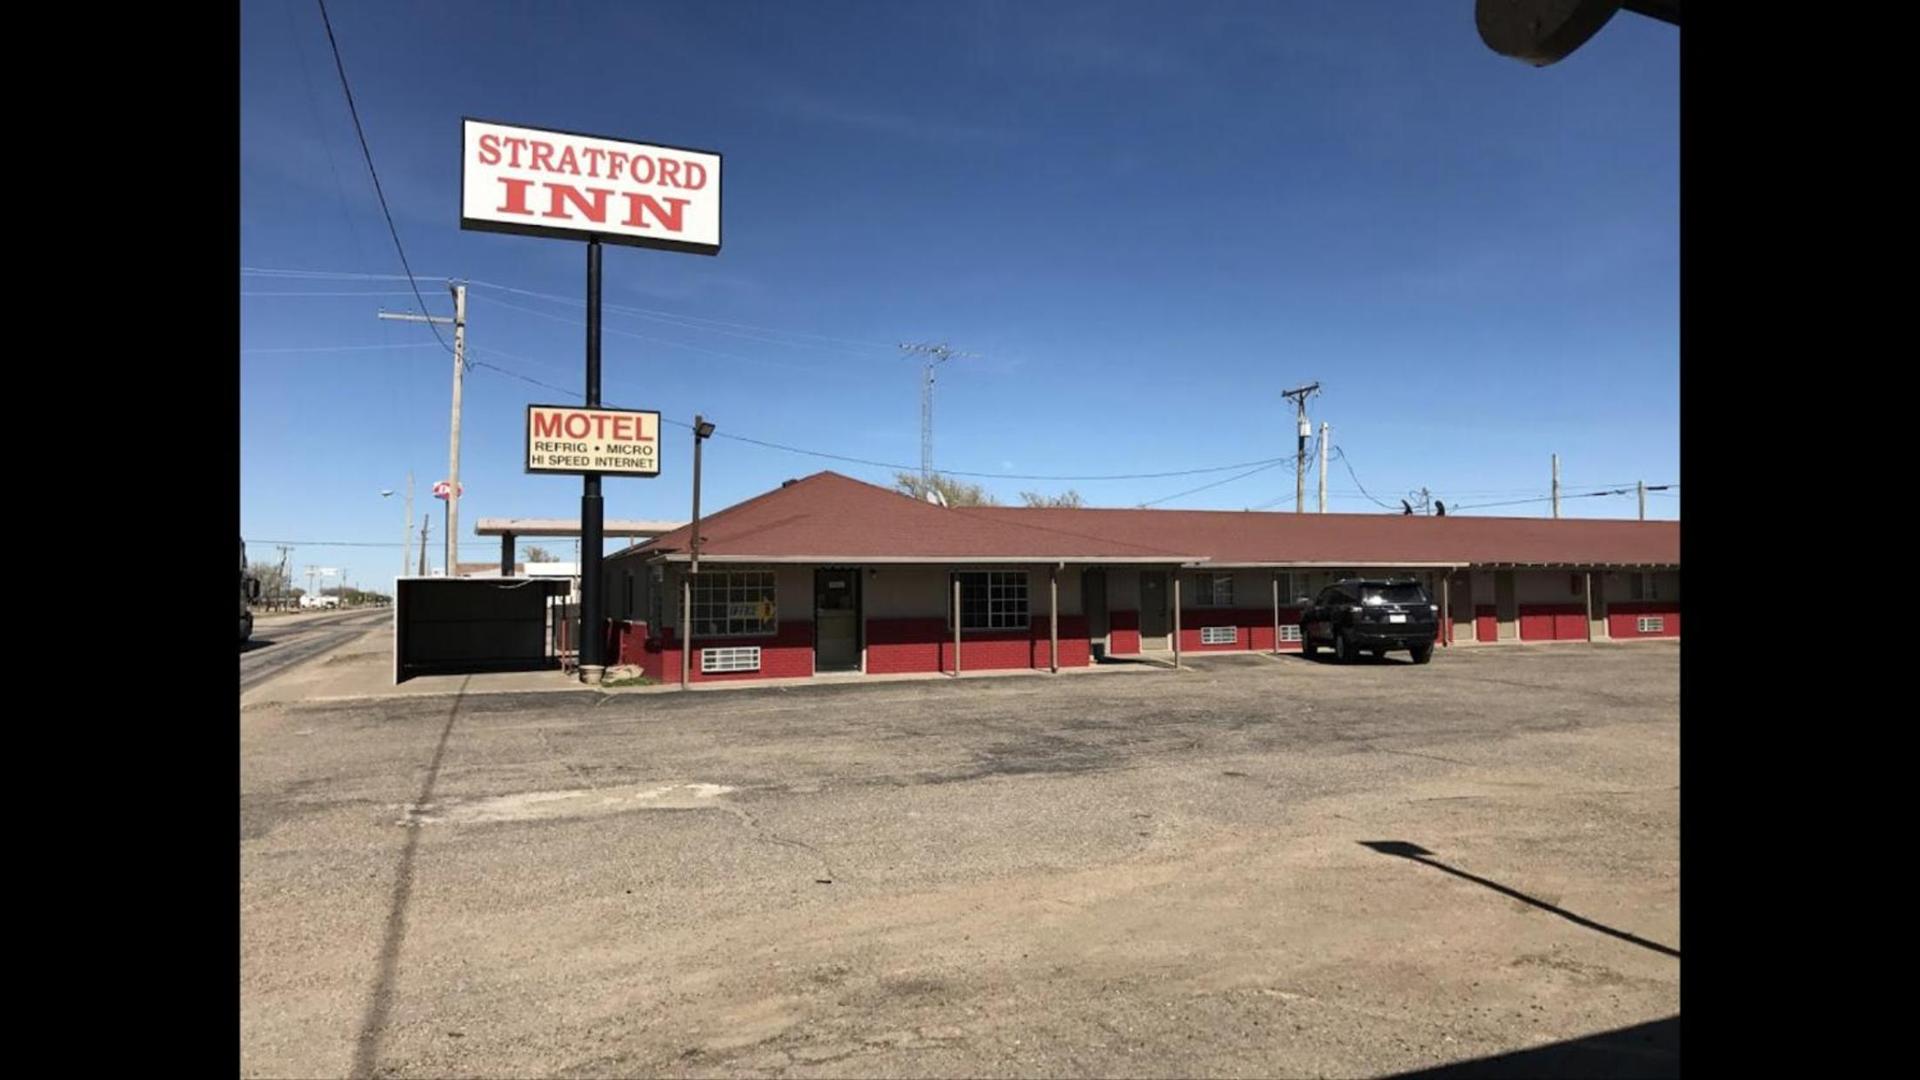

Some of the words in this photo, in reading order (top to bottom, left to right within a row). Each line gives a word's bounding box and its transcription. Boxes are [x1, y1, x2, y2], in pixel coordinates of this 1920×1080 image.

[478, 134, 707, 190] STRATFORD
[496, 177, 691, 232] INN
[534, 412, 654, 441] MOTEL
[532, 454, 544, 465] HI
[548, 455, 590, 466] SPEED
[595, 456, 654, 469] INTERNET
[534, 441, 588, 453] REFRIG
[606, 444, 653, 456] MICRO
